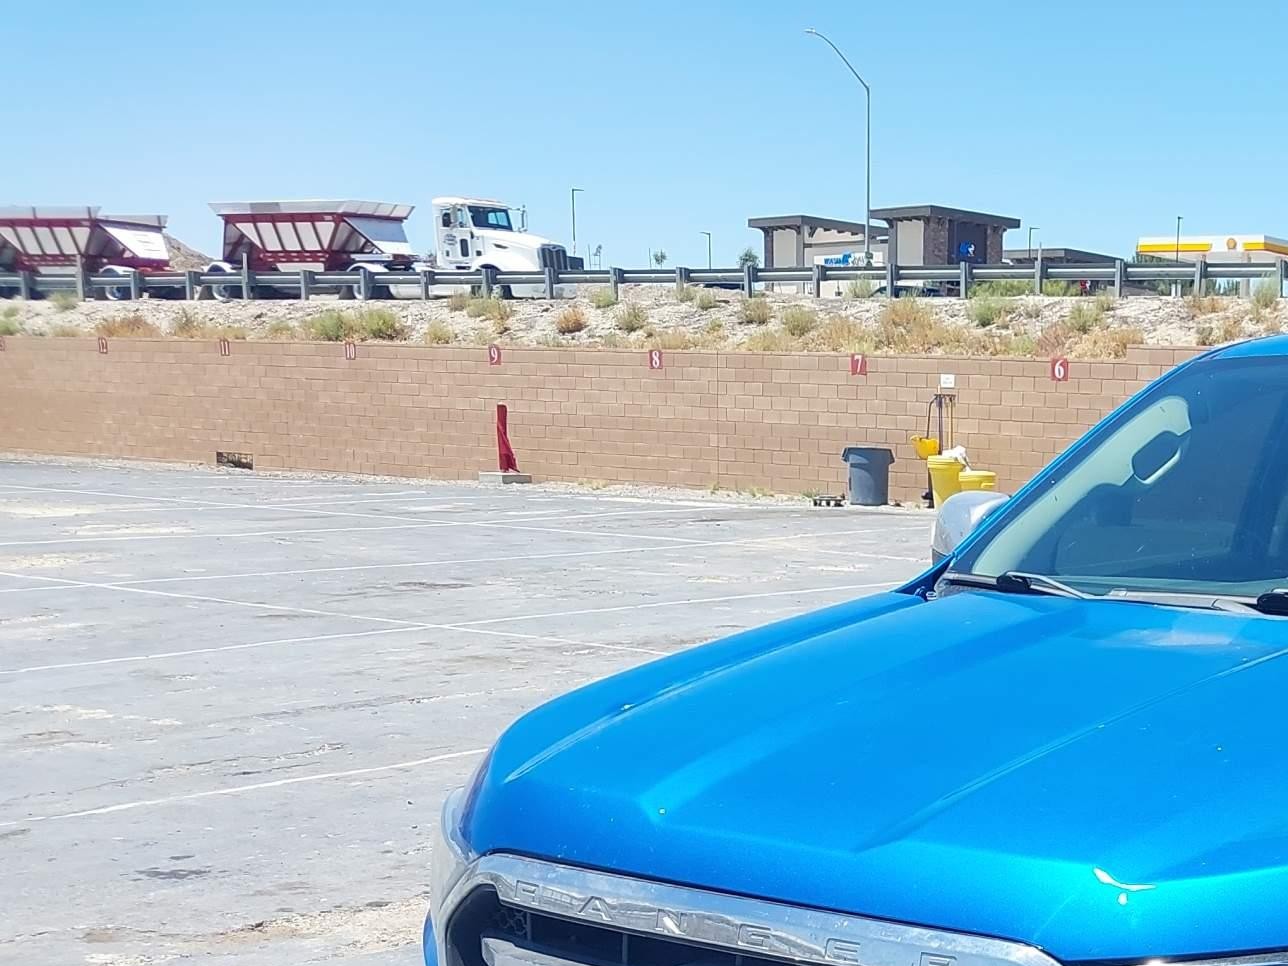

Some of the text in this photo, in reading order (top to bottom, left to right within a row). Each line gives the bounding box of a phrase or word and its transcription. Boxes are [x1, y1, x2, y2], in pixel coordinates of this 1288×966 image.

[220, 341, 229, 355] 11
[345, 343, 355, 359] 10
[490, 347, 498, 363] 9
[652, 350, 660, 368] 8
[853, 355, 863, 373] 7
[1054, 359, 1065, 379] 6
